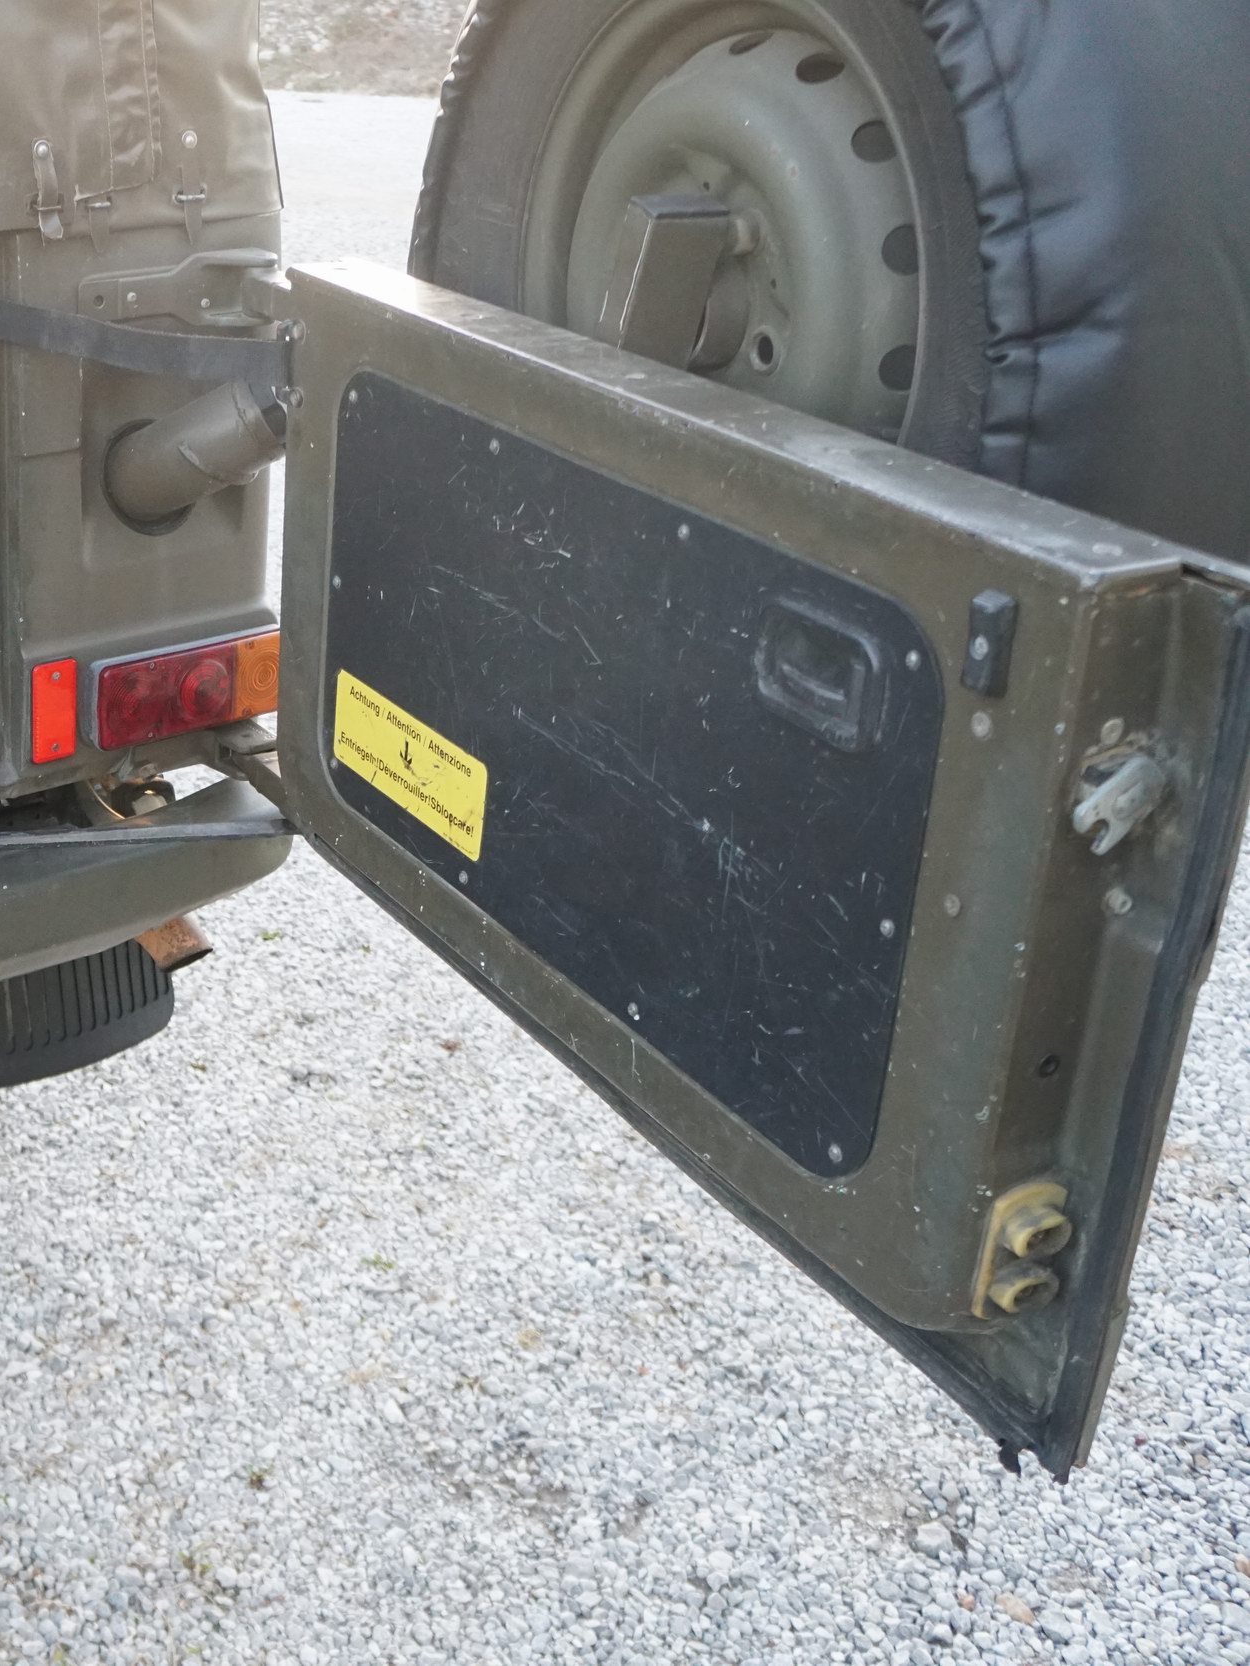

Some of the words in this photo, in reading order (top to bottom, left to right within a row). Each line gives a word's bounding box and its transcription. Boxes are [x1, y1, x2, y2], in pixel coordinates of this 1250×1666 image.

[350, 686, 380, 717] Achtung
[386, 711, 421, 743] Attention
[428, 739, 472, 777] Attenzione
